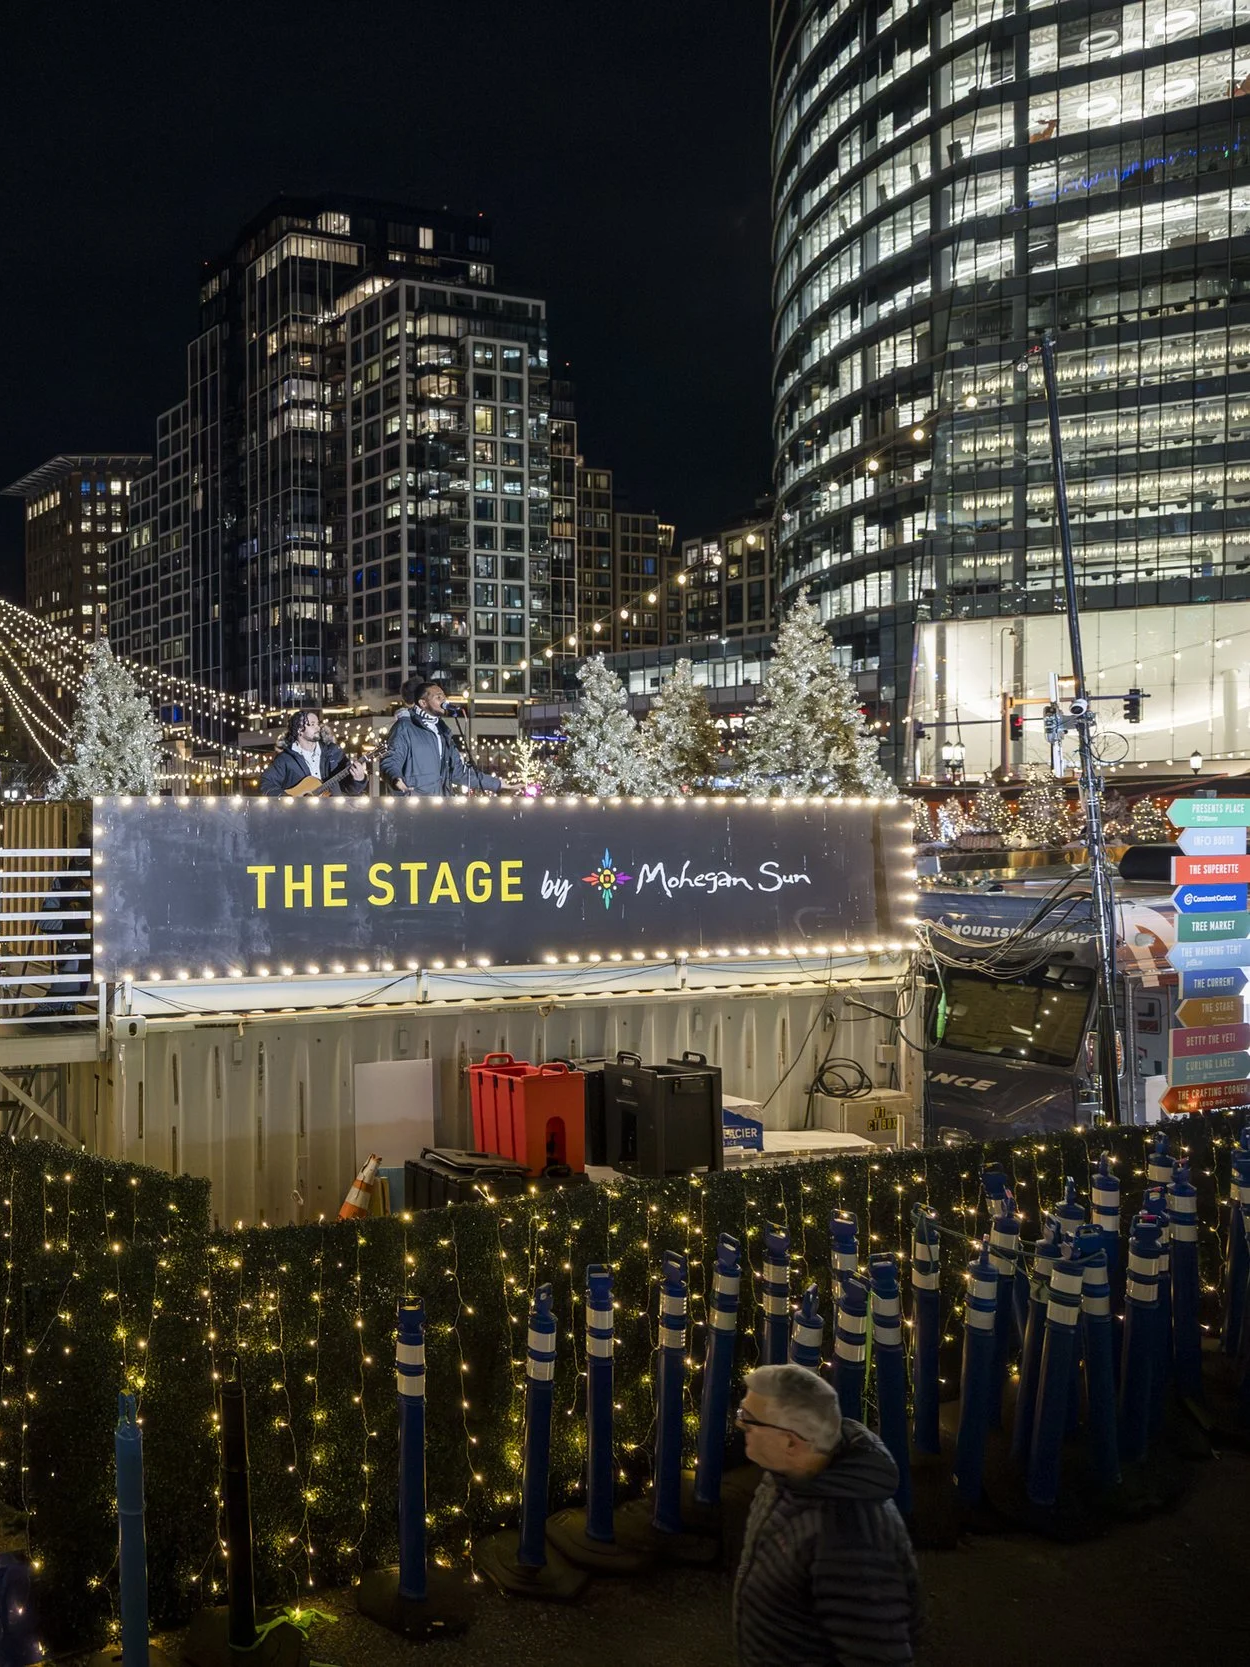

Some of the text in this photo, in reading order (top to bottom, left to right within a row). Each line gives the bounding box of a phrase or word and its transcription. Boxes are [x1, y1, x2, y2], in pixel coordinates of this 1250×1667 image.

[1192, 803, 1244, 813] PRESENTS PLACE
[1193, 835, 1234, 845] INFO BOOTH
[1190, 863, 1239, 875] THE SUPERETTE
[248, 860, 524, 909] THE STAGE
[540, 857, 812, 909] by Mohegan Sun
[1192, 920, 1235, 931] TREE MARKET
[1182, 944, 1242, 957] THE WARMING TENT
[1194, 976, 1235, 989] THE CURRENT
[1202, 1001, 1234, 1012] THE STAGE
[1186, 1032, 1236, 1047] BETTY THE YETI
[1186, 1057, 1235, 1072] CURLING LANES
[1178, 1083, 1248, 1101] THE CRAFTING CORNER
